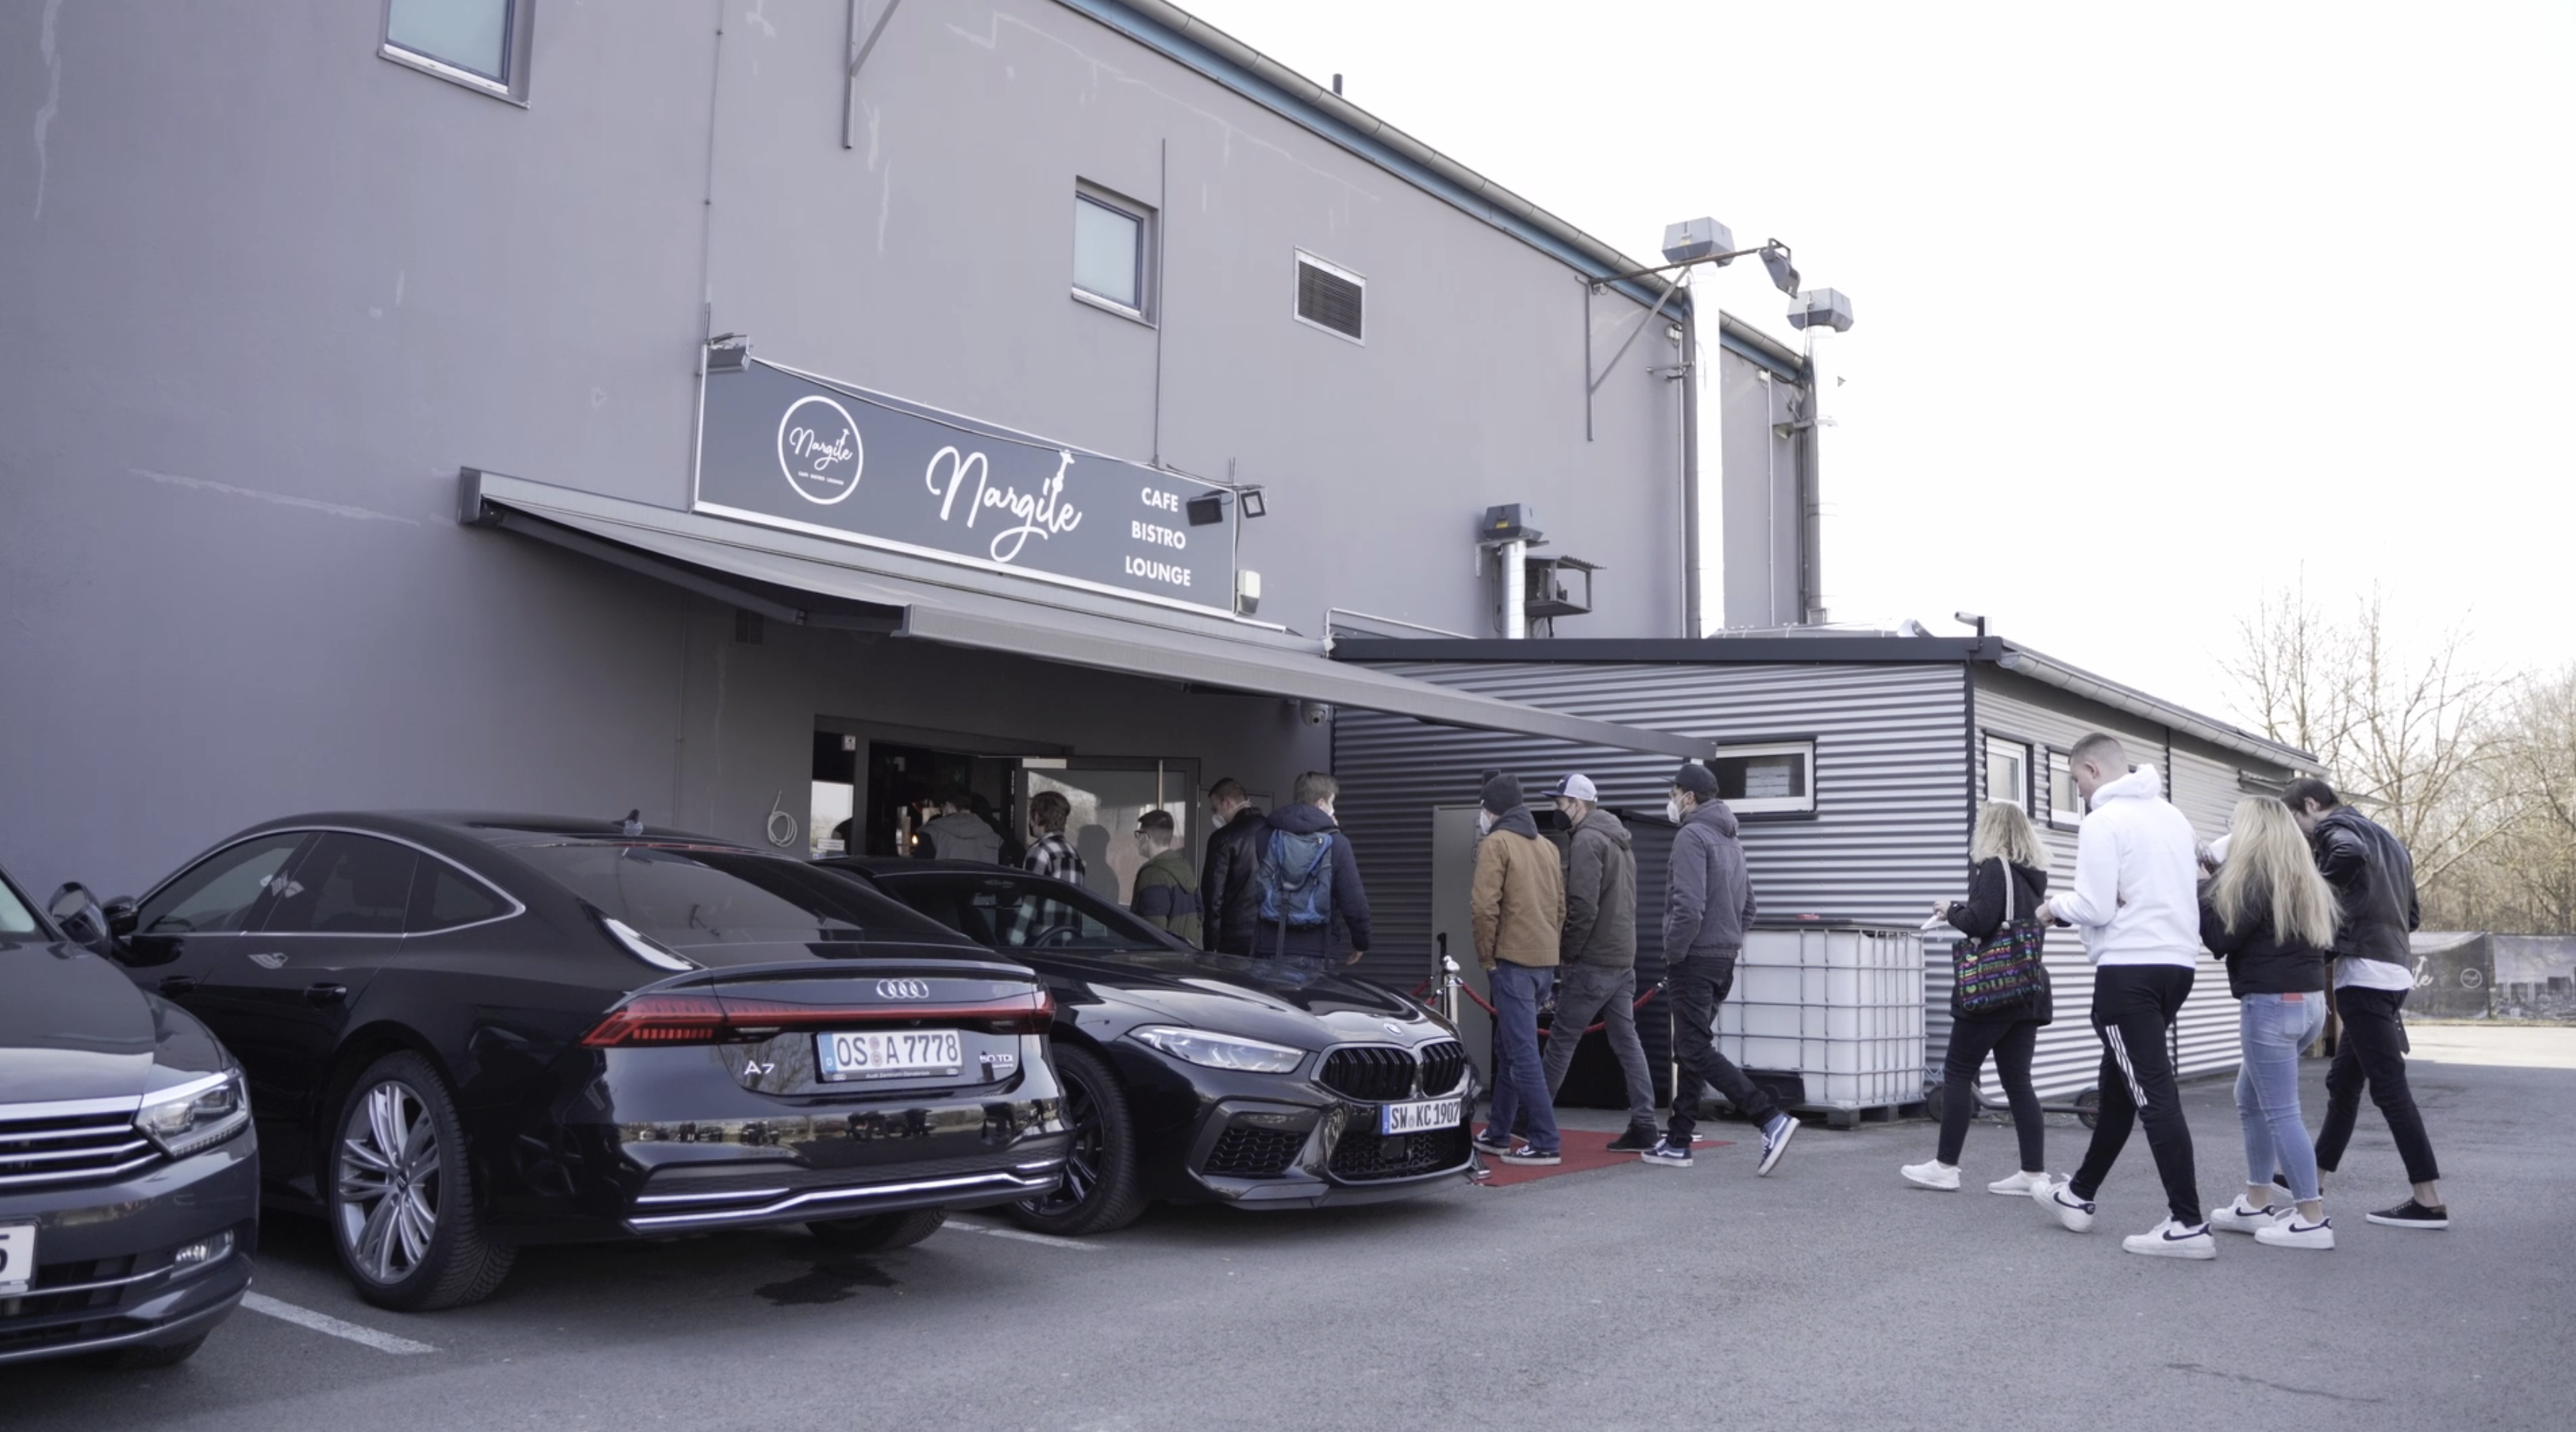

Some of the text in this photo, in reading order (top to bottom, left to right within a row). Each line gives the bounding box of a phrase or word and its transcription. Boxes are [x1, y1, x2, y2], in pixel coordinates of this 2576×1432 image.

[789, 427, 853, 471] Nargile
[925, 446, 1082, 563] Nargile
[1142, 487, 1178, 512] CAFE
[1132, 520, 1186, 549] BISTRO
[1125, 555, 1190, 586] LOUNGE
[837, 1033, 958, 1066] OS A 7778
[745, 1060, 775, 1075] A7
[1391, 1102, 1459, 1130] SW KC 1907
